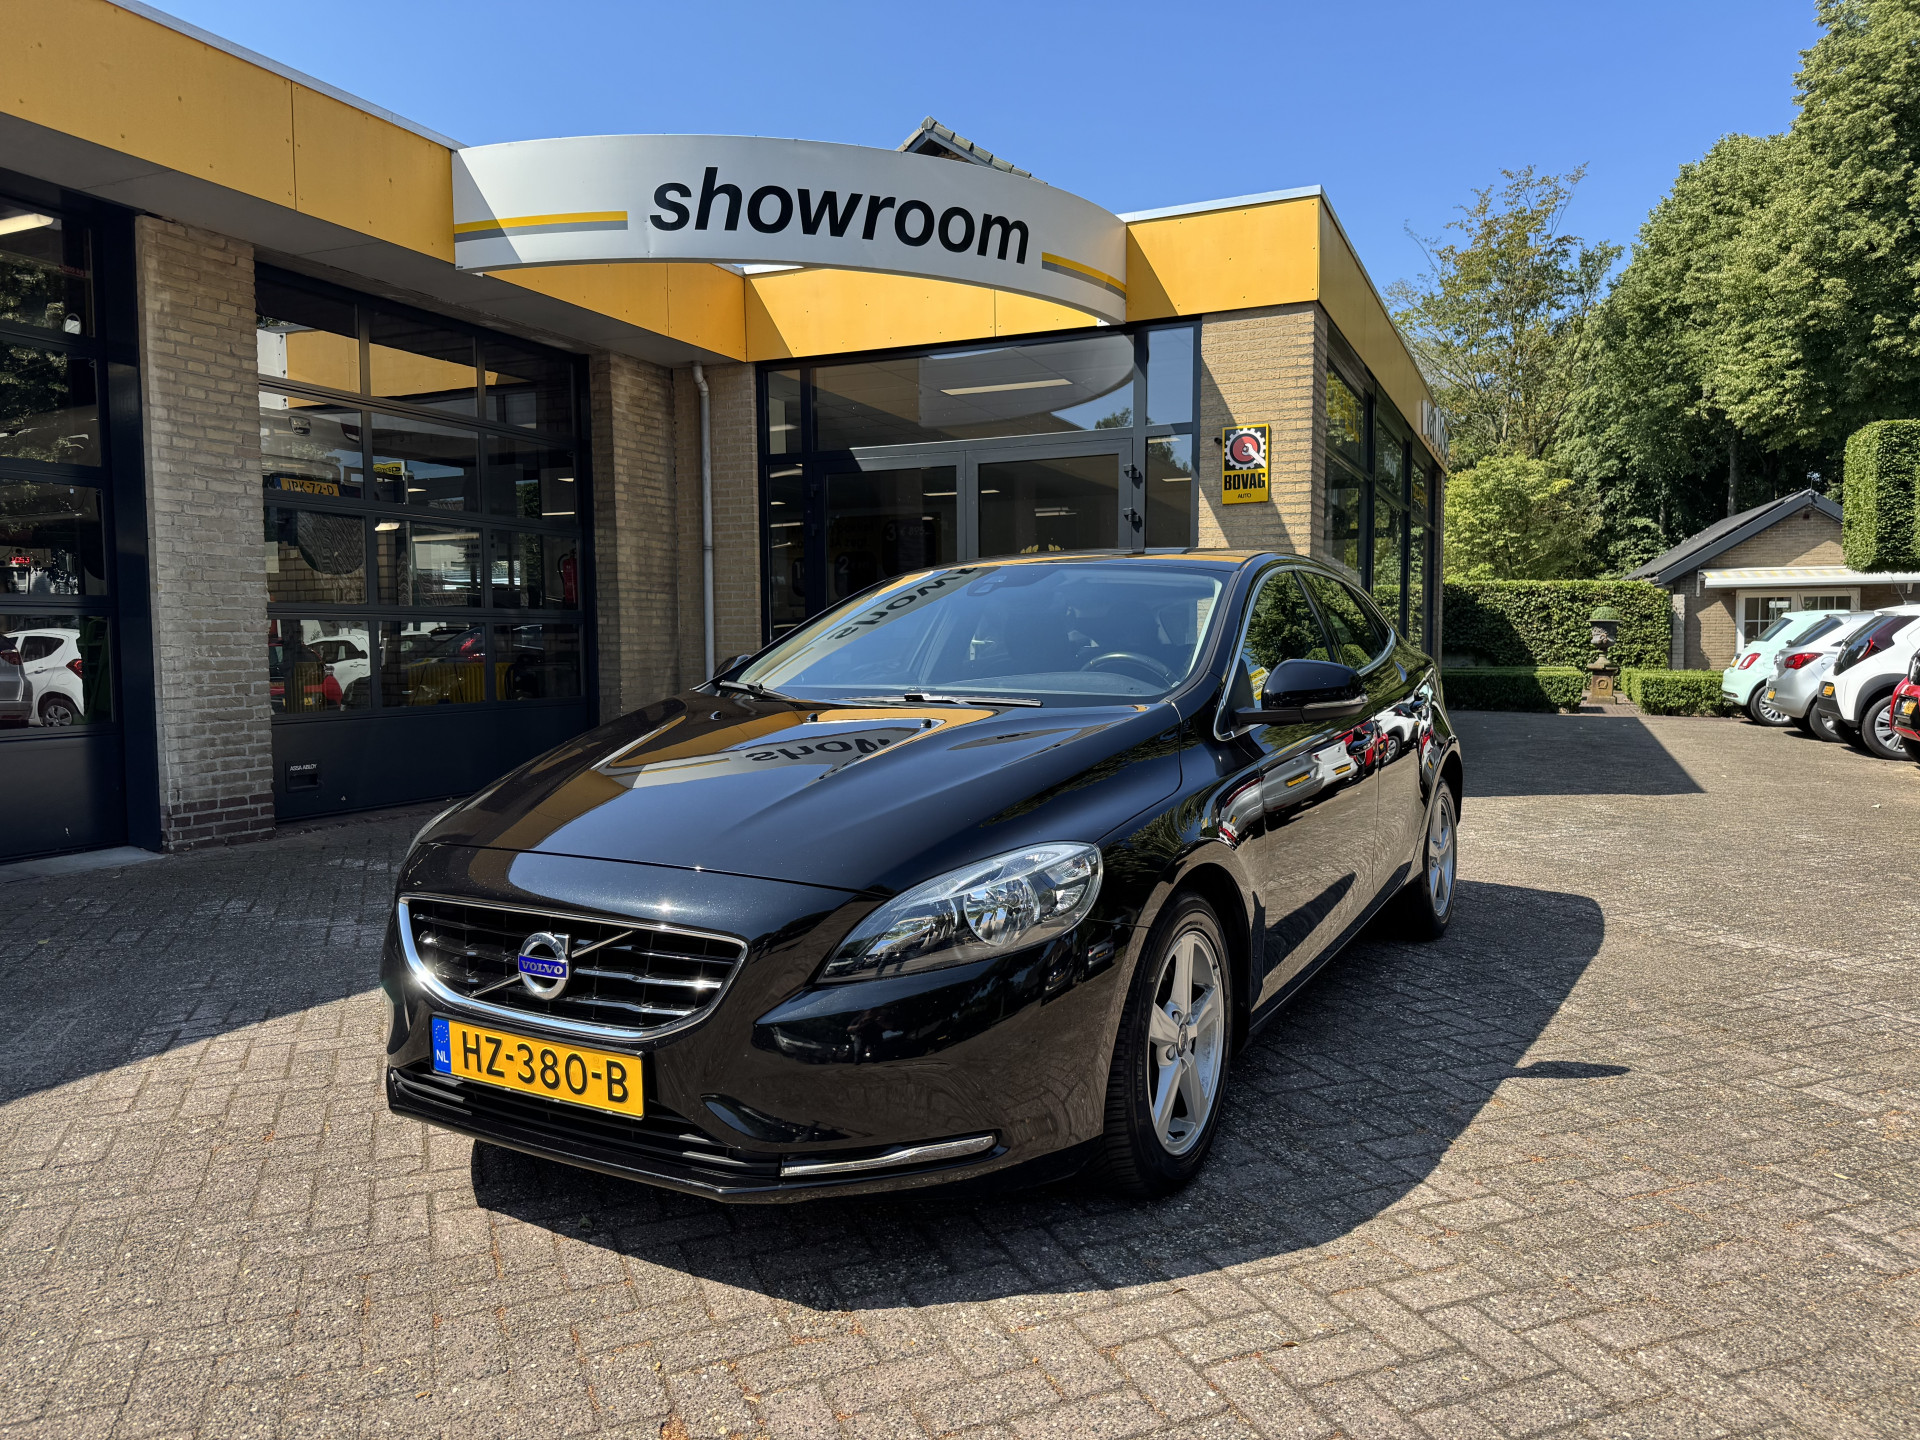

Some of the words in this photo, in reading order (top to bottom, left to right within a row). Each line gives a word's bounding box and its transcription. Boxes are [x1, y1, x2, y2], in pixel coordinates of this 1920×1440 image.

[648, 166, 1030, 265] showroom
[1223, 472, 1266, 491] BOVAG
[520, 959, 564, 975] VOLVO
[436, 1050, 450, 1064] NL
[461, 1029, 630, 1104] HZ-380-B
